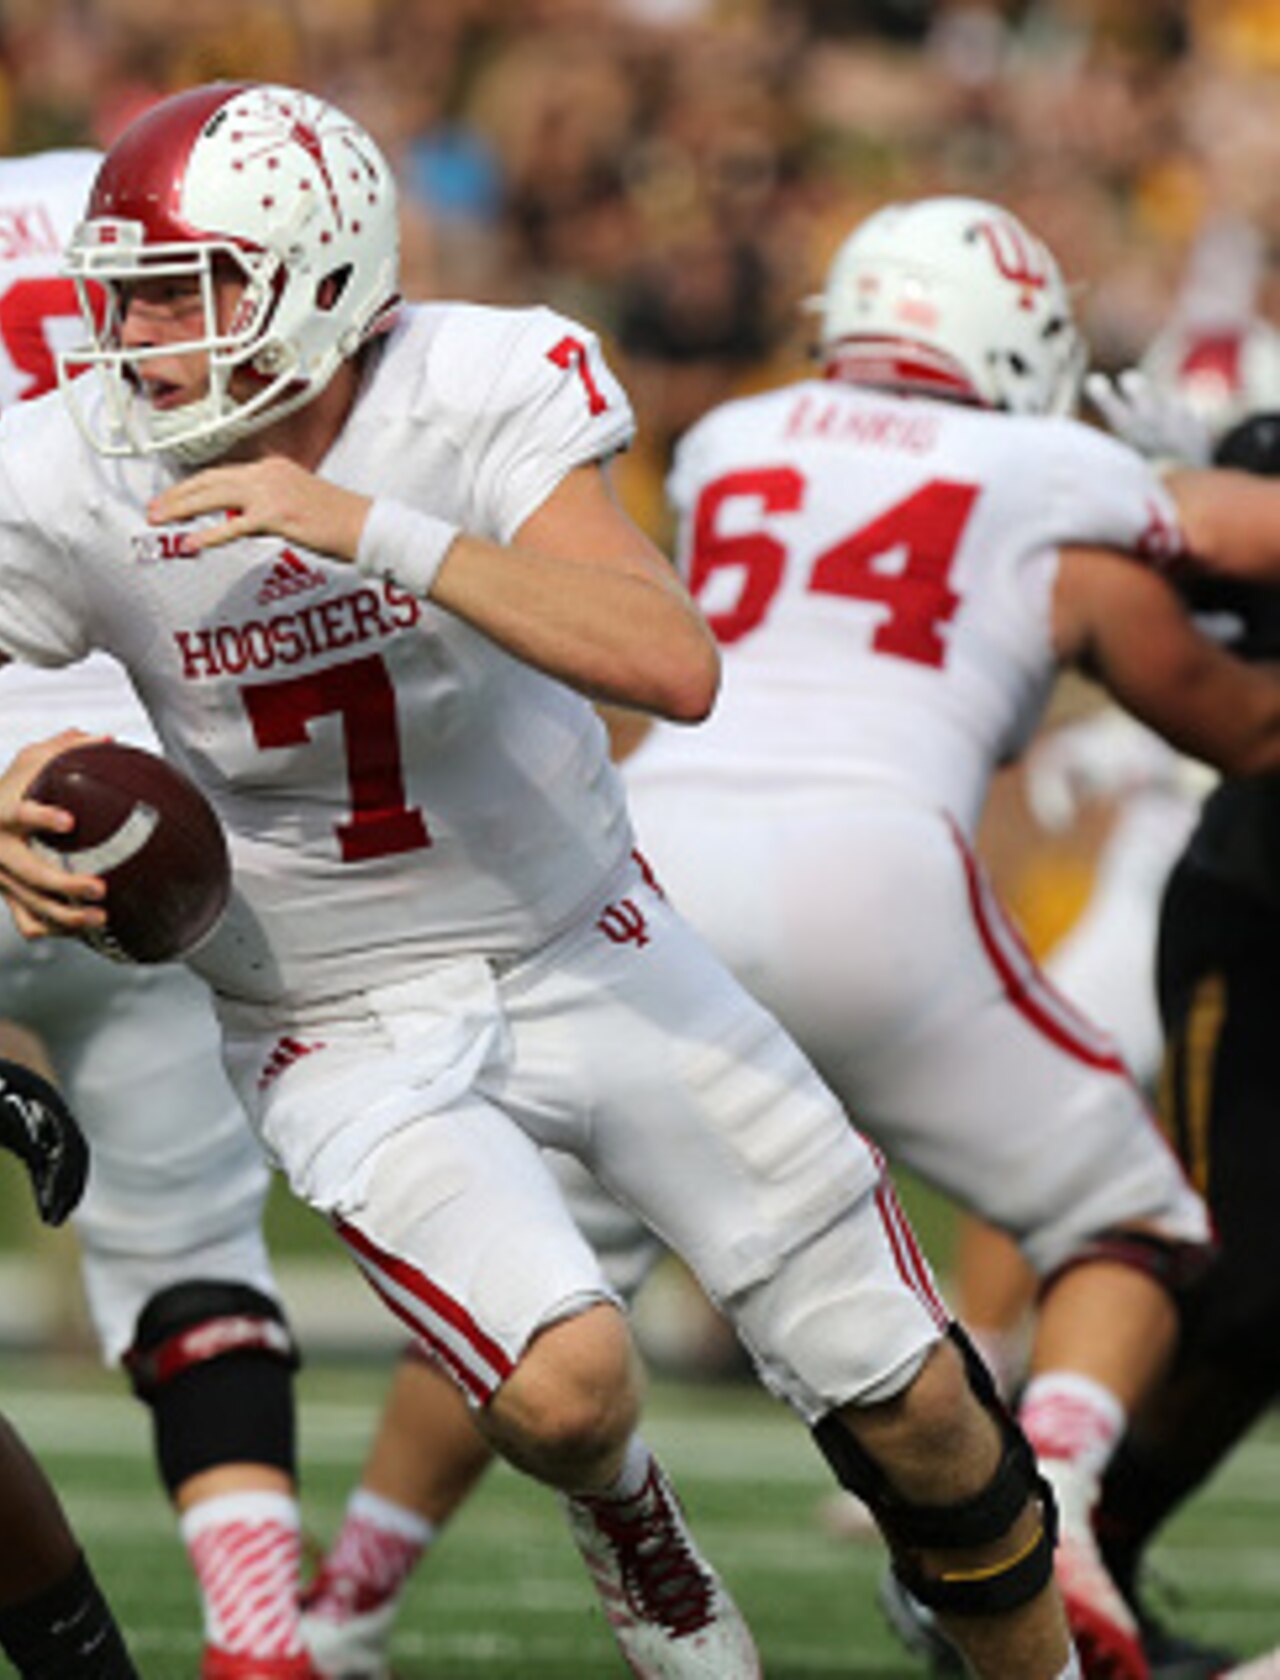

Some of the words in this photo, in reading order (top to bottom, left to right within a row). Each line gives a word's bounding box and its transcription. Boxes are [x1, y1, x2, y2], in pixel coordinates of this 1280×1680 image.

[547, 335, 607, 417] 7
[173, 580, 422, 681] HOOSIERS
[688, 465, 983, 671] 64
[239, 652, 432, 864] 7
